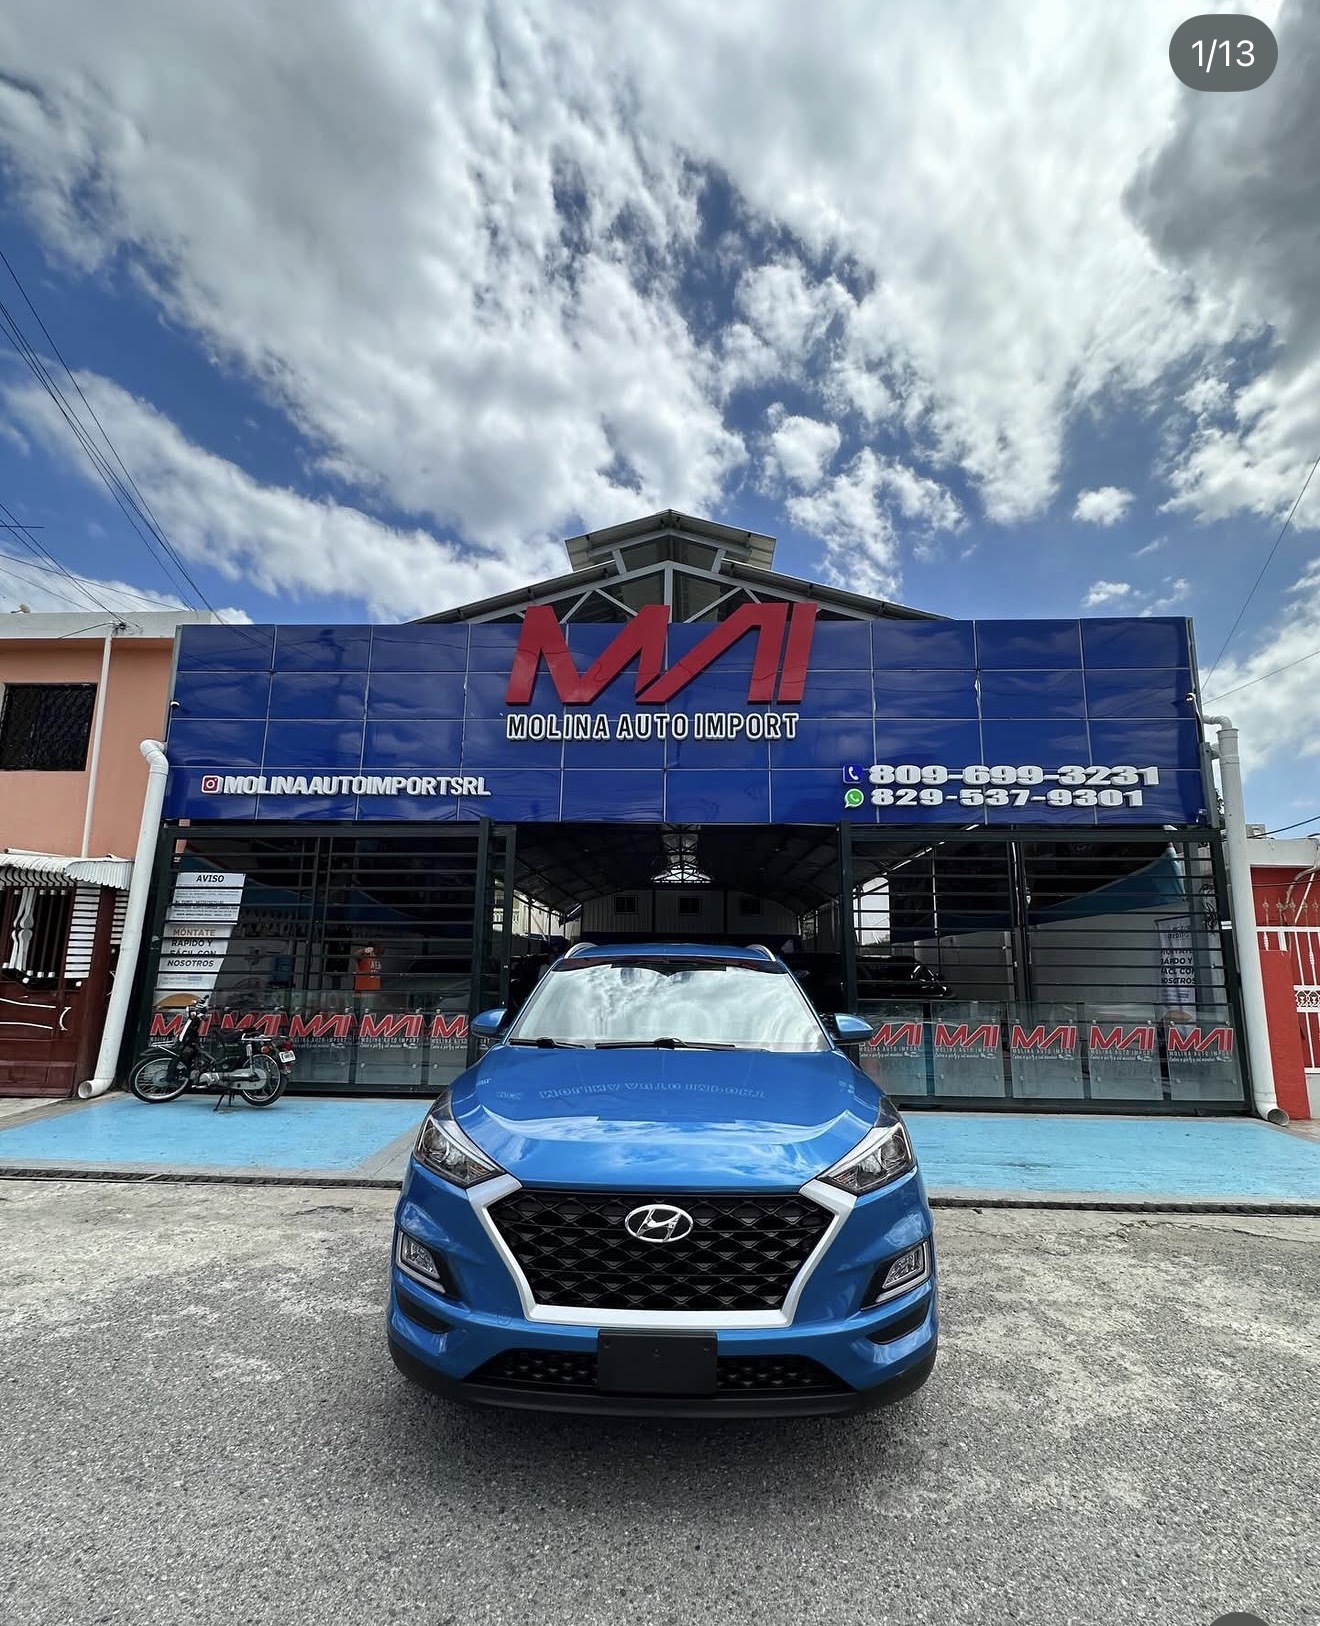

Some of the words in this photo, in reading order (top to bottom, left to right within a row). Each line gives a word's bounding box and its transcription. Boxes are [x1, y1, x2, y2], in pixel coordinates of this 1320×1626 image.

[505, 602, 817, 705] MAI
[506, 713, 610, 741] MOLINA
[616, 713, 689, 741] AUTO
[694, 712, 799, 741] IMPORT
[223, 775, 491, 796] MOLINAAUTOIMPORTSRL
[868, 764, 1159, 786] 809-699-3231
[870, 788, 1143, 807] 829-537-9301
[196, 874, 225, 882] AVISO
[288, 1014, 351, 1037] MAI
[359, 1014, 423, 1038] MAI
[934, 1024, 999, 1048] MAI
[1011, 1025, 1077, 1049] MAI
[1088, 1026, 1155, 1050] MAI
[1166, 1027, 1234, 1051] MAI
